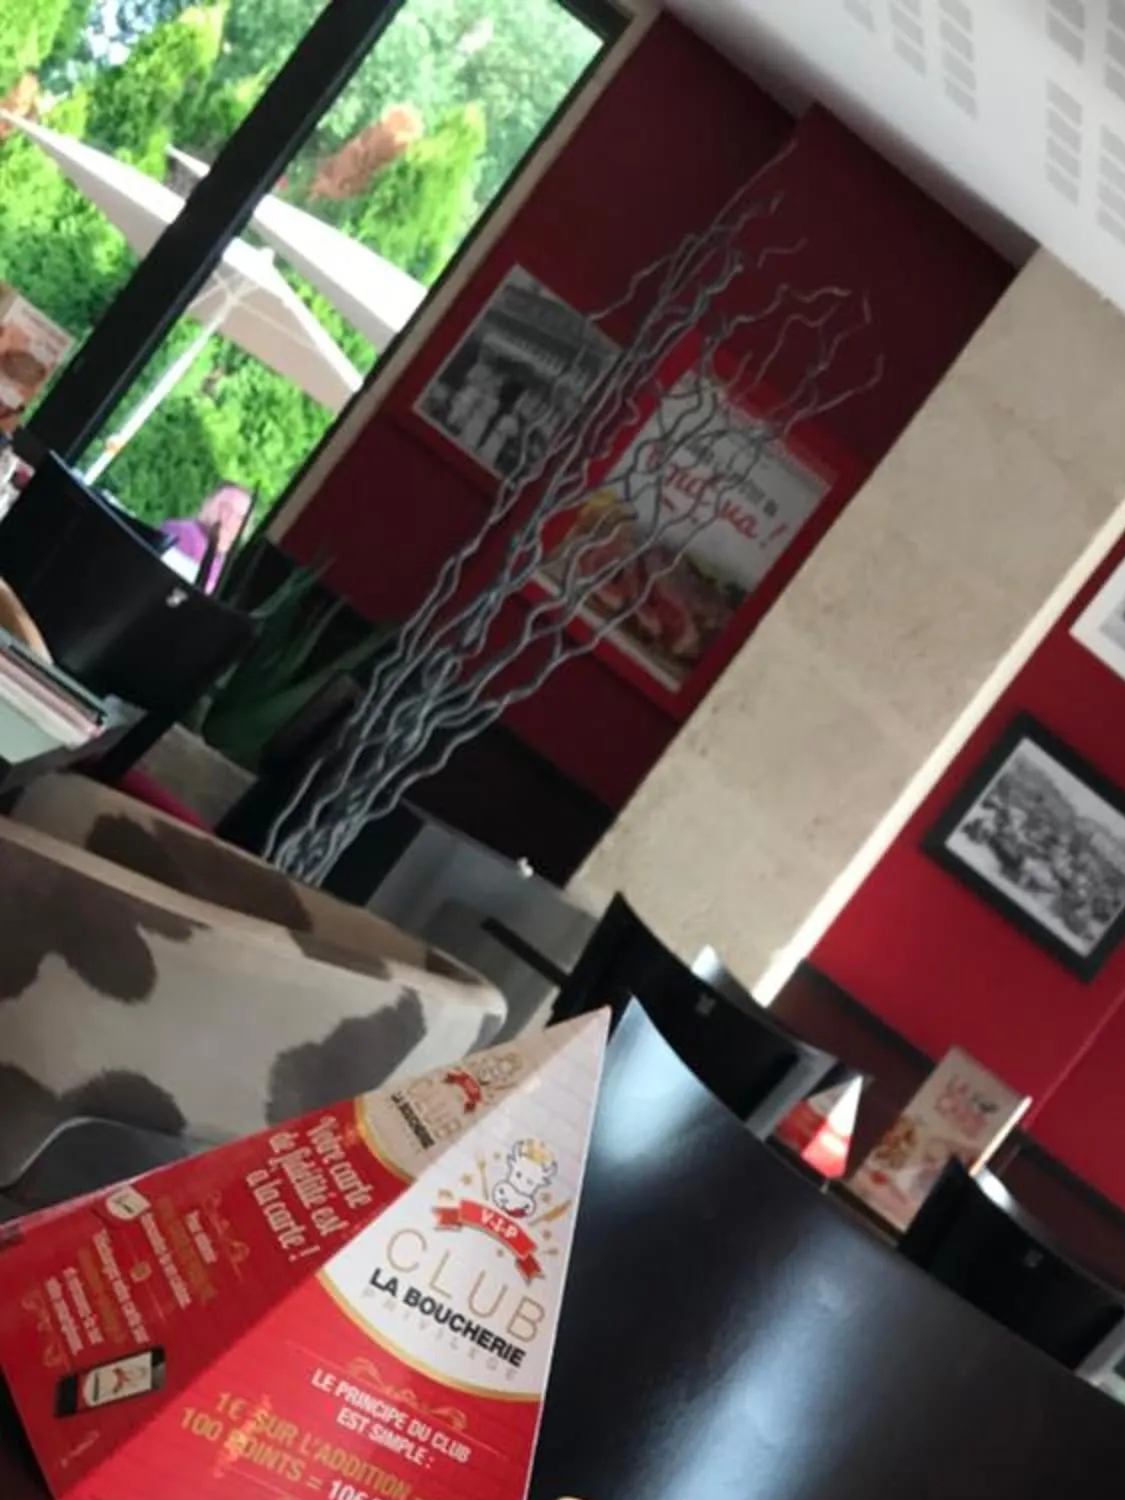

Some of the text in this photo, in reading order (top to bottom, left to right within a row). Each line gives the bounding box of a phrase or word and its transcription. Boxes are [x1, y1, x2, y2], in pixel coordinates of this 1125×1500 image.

[253, 1178, 283, 1205] la
[268, 1131, 298, 1153] de
[310, 1205, 350, 1237] est
[306, 1115, 374, 1210] Votre carte
[264, 1203, 305, 1251] carte
[369, 1268, 528, 1368] LA BOUCHERIE
[386, 1228, 546, 1344] CLUB
[181, 1406, 223, 1442] 100
[224, 1427, 308, 1482] POINTS
[215, 1391, 246, 1421] 1€
[251, 1407, 300, 1448] SUR
[311, 1368, 472, 1463] LE PRINCIPE DU CLUB
[336, 1406, 368, 1436] EST
[368, 1421, 427, 1466] SIMPLE
